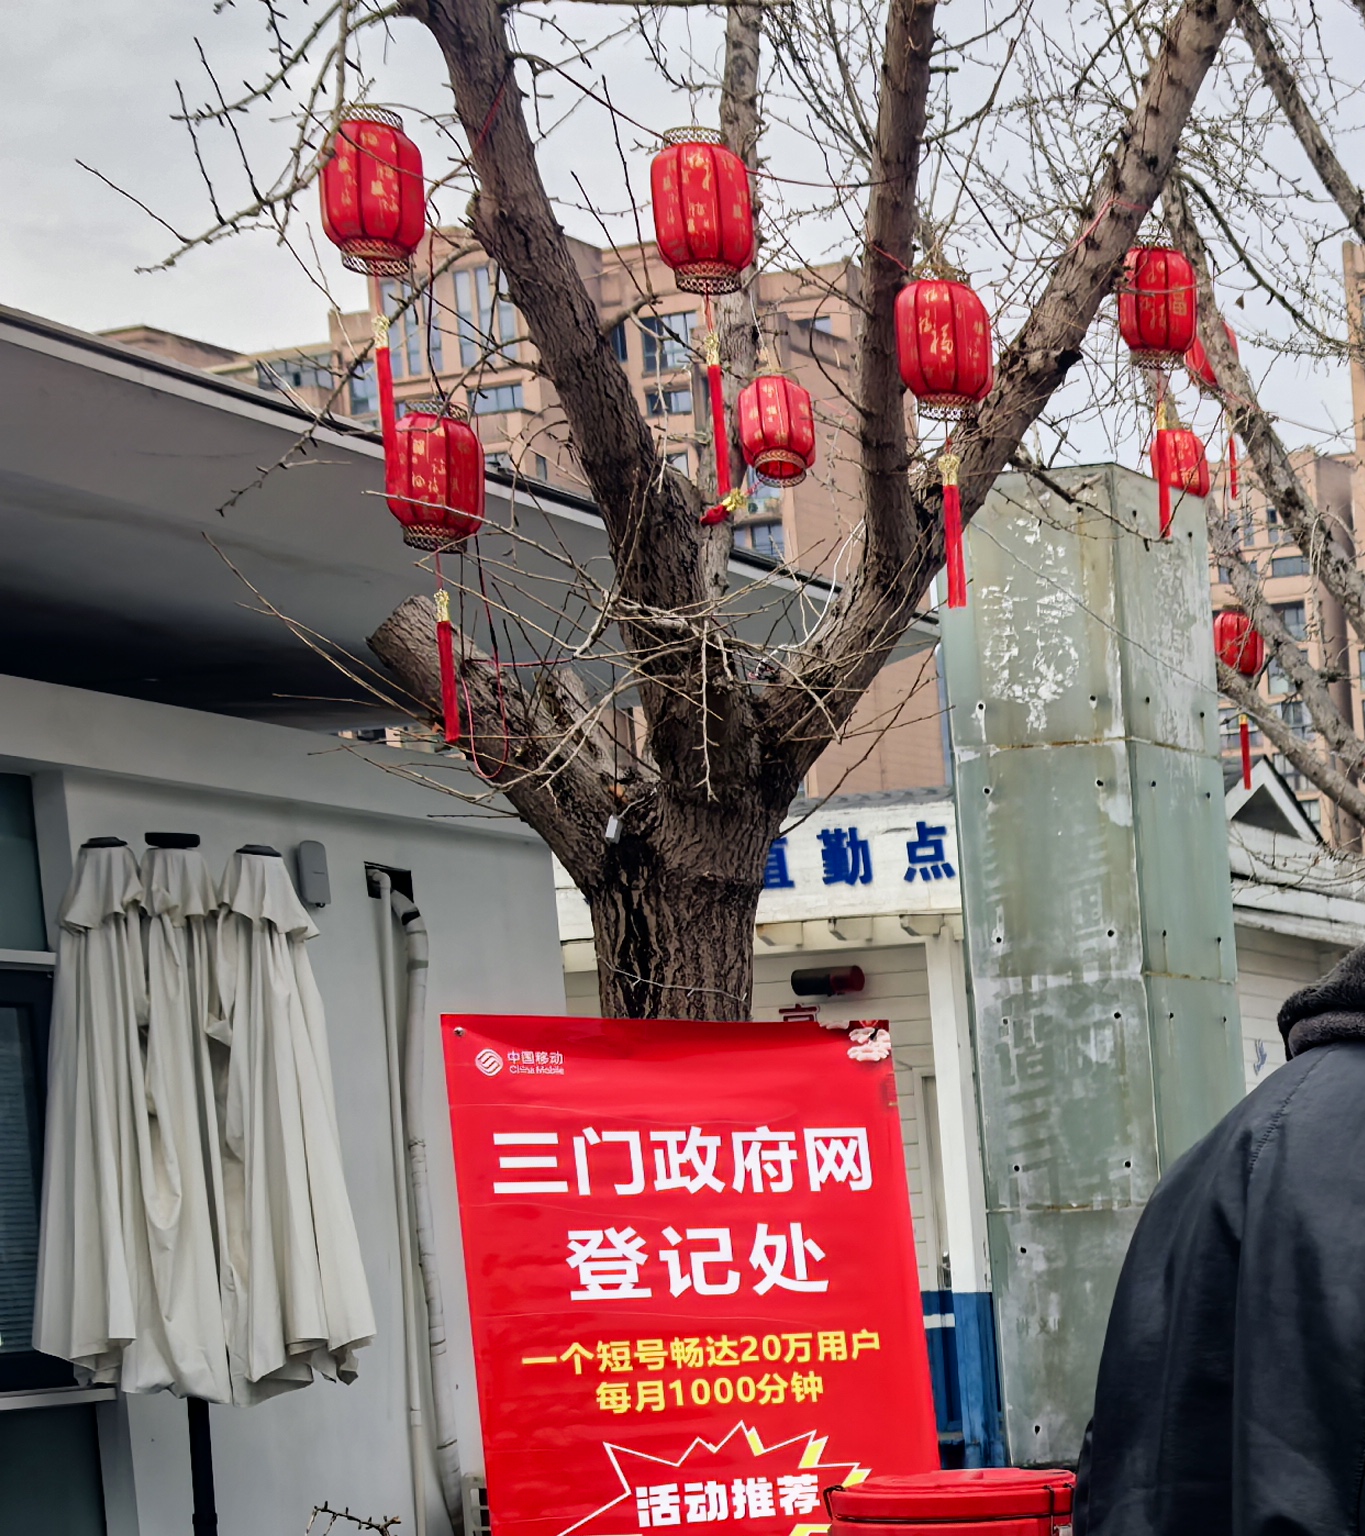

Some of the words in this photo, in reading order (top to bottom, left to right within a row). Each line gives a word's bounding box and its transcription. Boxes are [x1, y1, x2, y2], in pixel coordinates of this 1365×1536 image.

[507, 1050, 564, 1065] 中国移动
[509, 1065, 535, 1075] China
[536, 1066, 565, 1076] Mobile
[492, 1125, 873, 1196] 三门政府网
[565, 1222, 831, 1302] 登记处
[521, 1329, 882, 1375] 一个短号畅达20万用户
[595, 1372, 825, 1414] 每月1000分钟
[635, 1473, 822, 1528] 活动推荐
